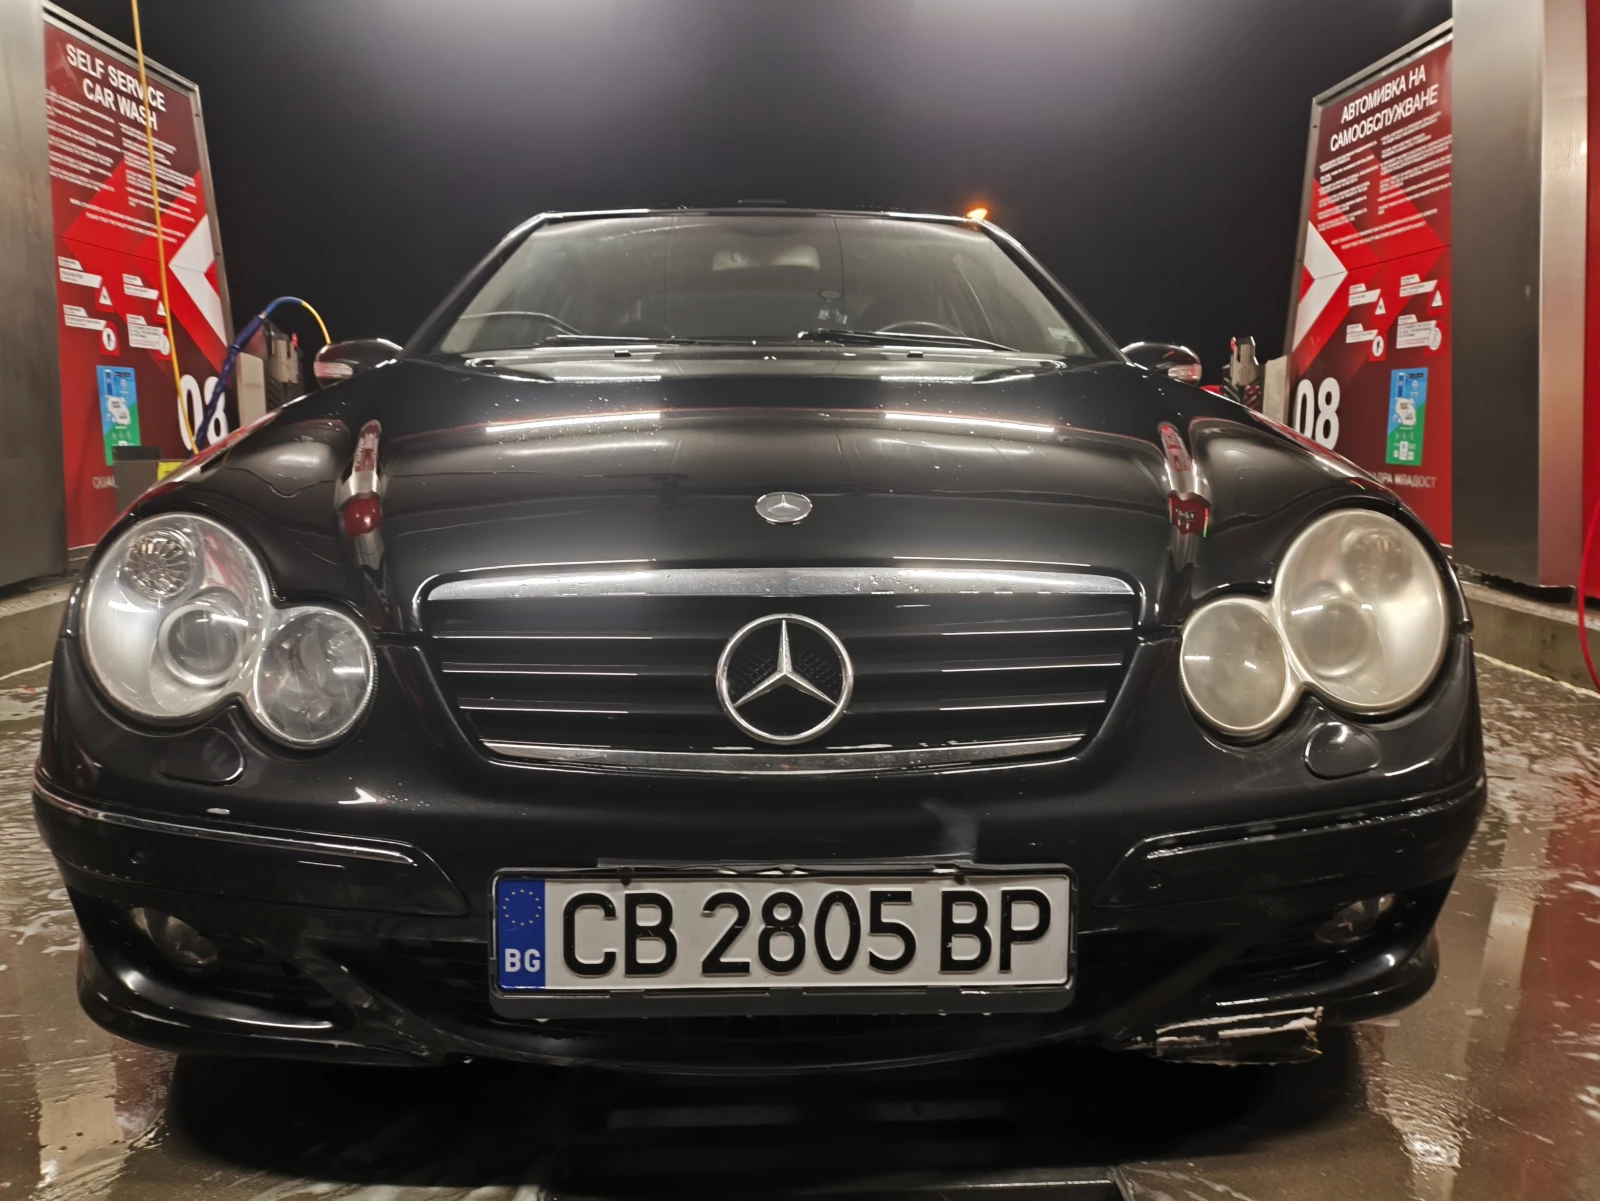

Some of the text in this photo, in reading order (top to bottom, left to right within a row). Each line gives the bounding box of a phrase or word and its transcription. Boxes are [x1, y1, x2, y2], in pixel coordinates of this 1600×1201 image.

[65, 43, 167, 112] SELF SERVCE
[82, 78, 158, 131] CAR WASH
[1340, 64, 1426, 124] АВТОМИВКА НА
[1330, 83, 1439, 152] САМООБСЛУЖВАНЕ
[1293, 376, 1341, 451] 08
[503, 949, 541, 973] BG
[562, 888, 1052, 977] CB 2805 BP
